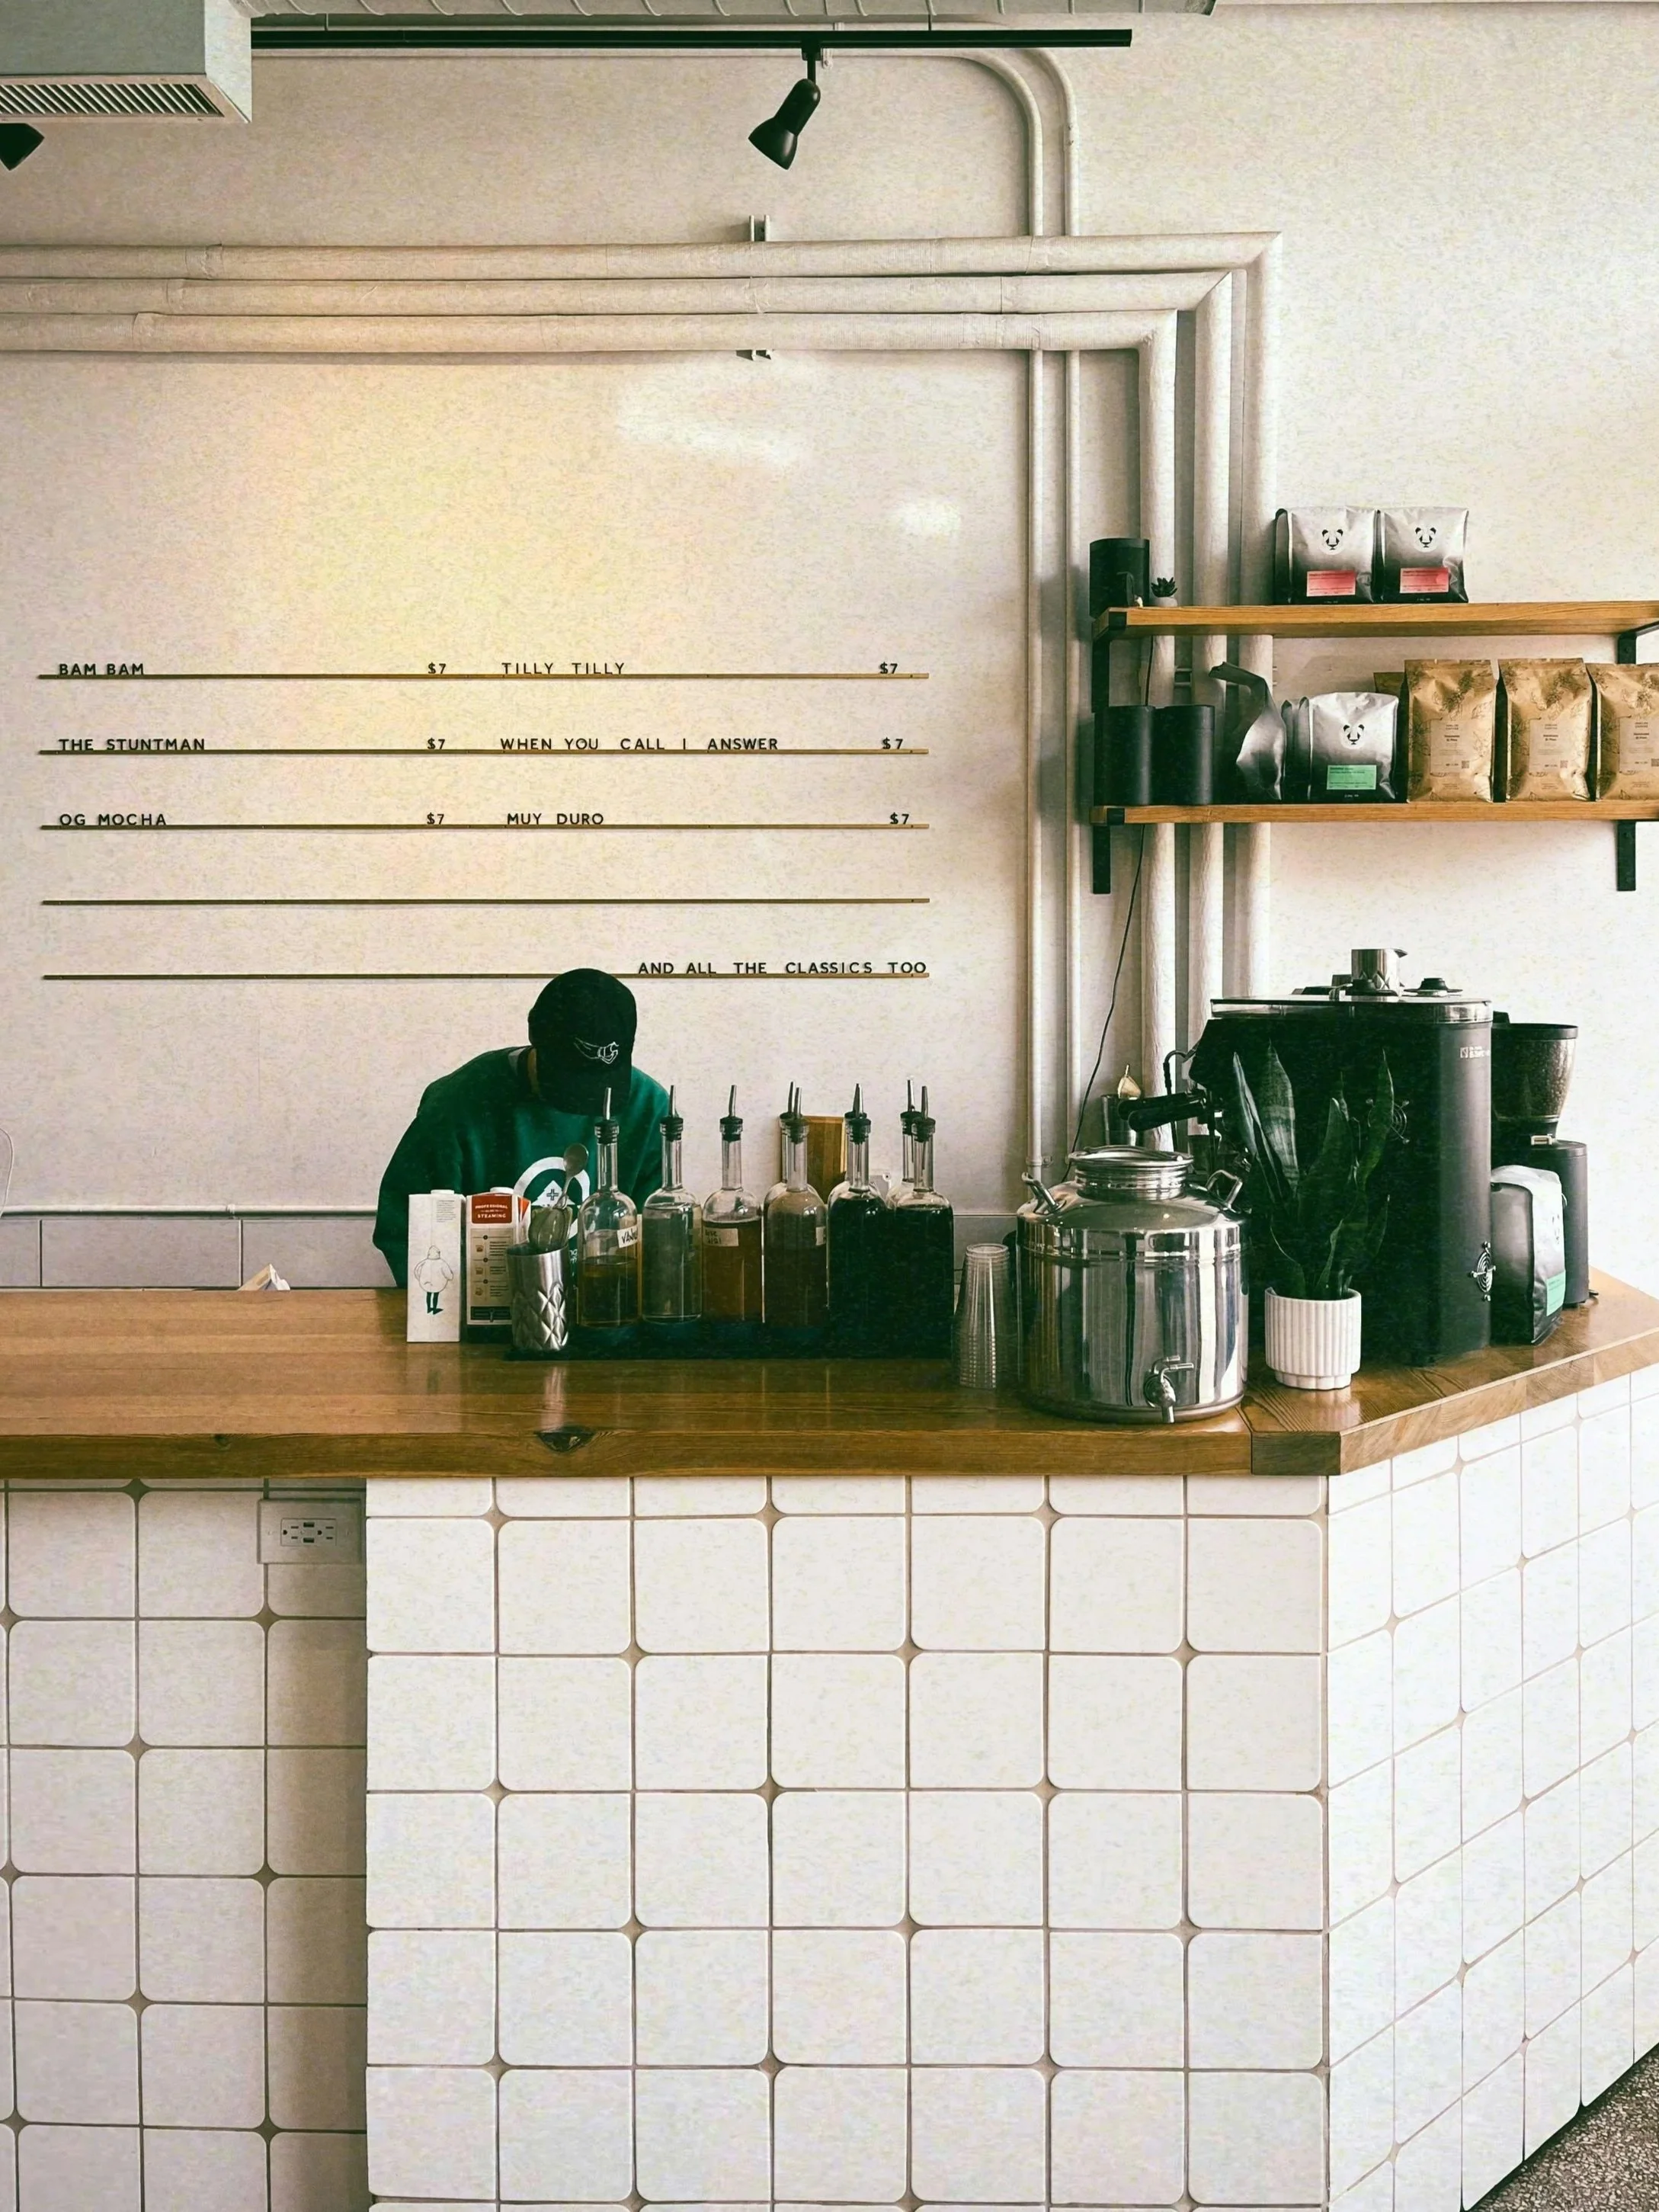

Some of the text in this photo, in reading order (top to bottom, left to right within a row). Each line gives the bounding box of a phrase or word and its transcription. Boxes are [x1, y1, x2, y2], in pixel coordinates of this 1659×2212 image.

[59, 663, 145, 675] BAM BAM
[427, 662, 447, 675] $7
[501, 662, 626, 675] TILLY TILLY
[879, 662, 898, 675] $7
[59, 738, 206, 751] THE STUNTMAN
[426, 737, 447, 751] $7
[500, 738, 779, 750] WHEN YOU CALL I ANSWER
[882, 737, 904, 750] $7
[59, 813, 168, 826] OG MOCHA
[426, 812, 446, 826] $7
[506, 813, 604, 825] MUY DURO
[889, 812, 911, 825] $7
[638, 962, 927, 975] AND ALL THE CLASSICS TOO
